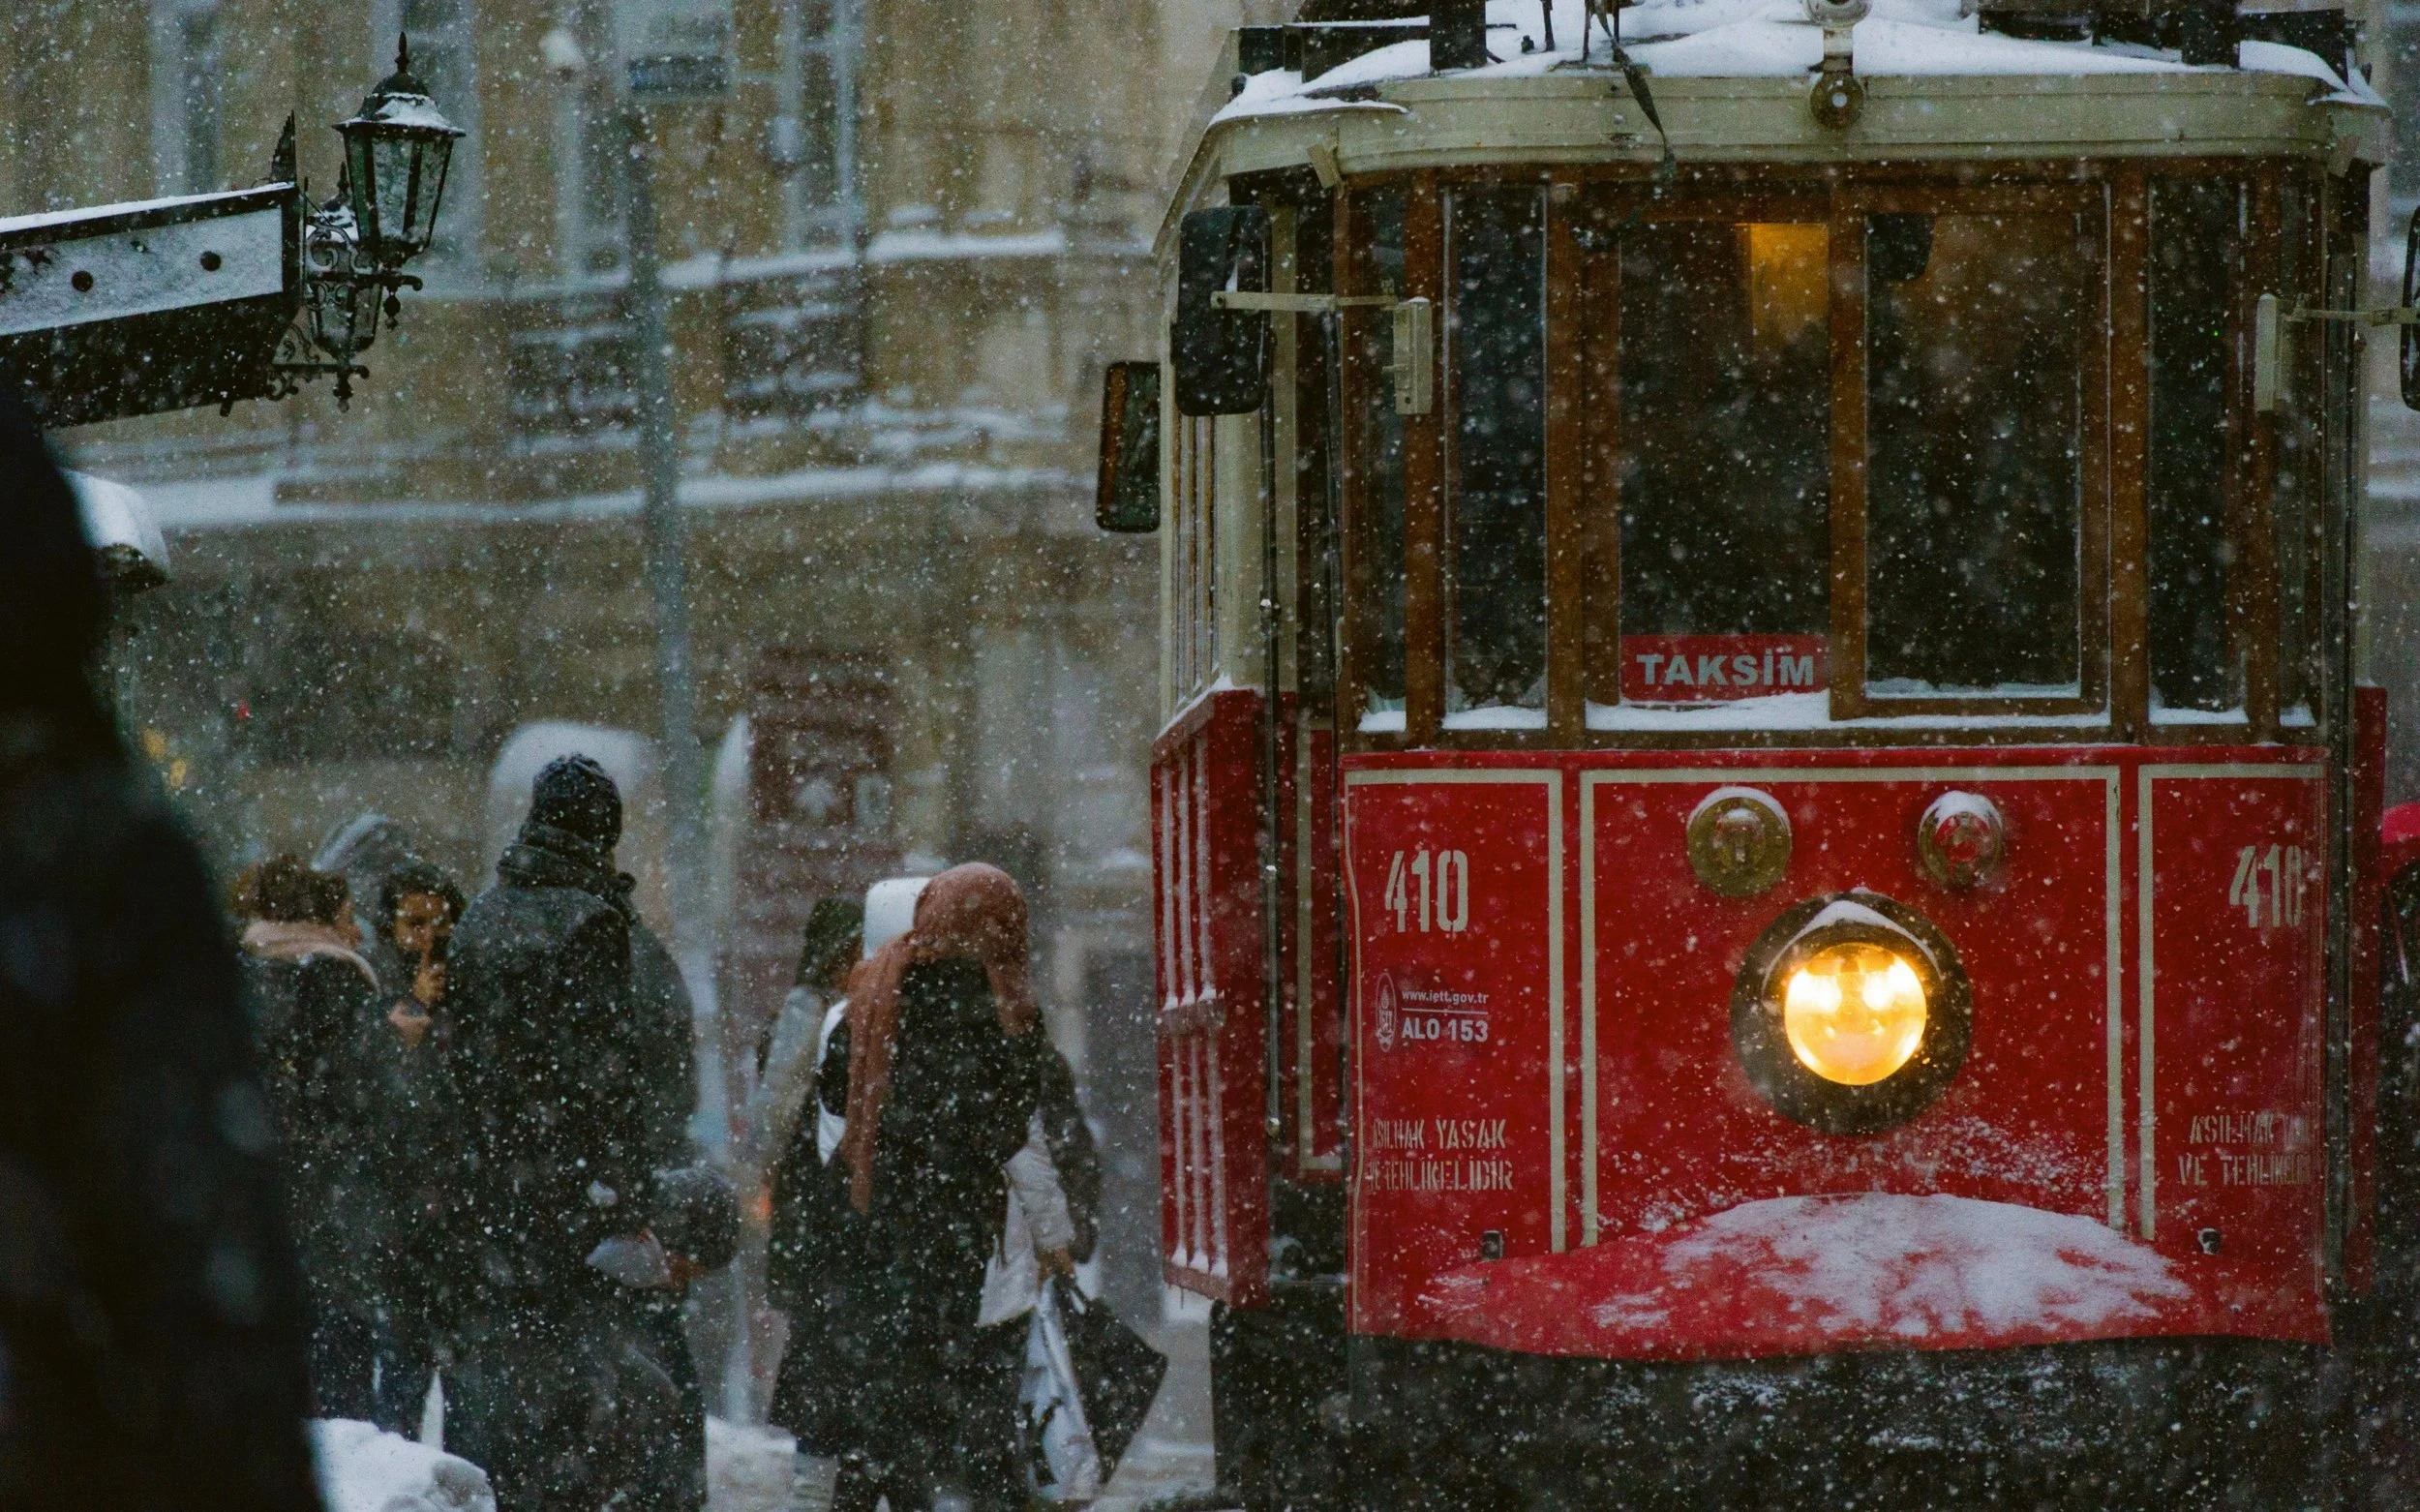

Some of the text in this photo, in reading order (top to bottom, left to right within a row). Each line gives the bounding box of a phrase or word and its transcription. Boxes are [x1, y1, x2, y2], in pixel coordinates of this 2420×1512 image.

[1637, 648, 1813, 685] TAKSİM
[1385, 850, 1468, 932] 410
[2229, 843, 2302, 928] 410
[1402, 990, 1489, 1005] www.iett.gov.tr
[1402, 1017, 1488, 1043] ALO 153
[1436, 1118, 1506, 1149] YASAK
[2178, 1153, 2208, 1185] VE
